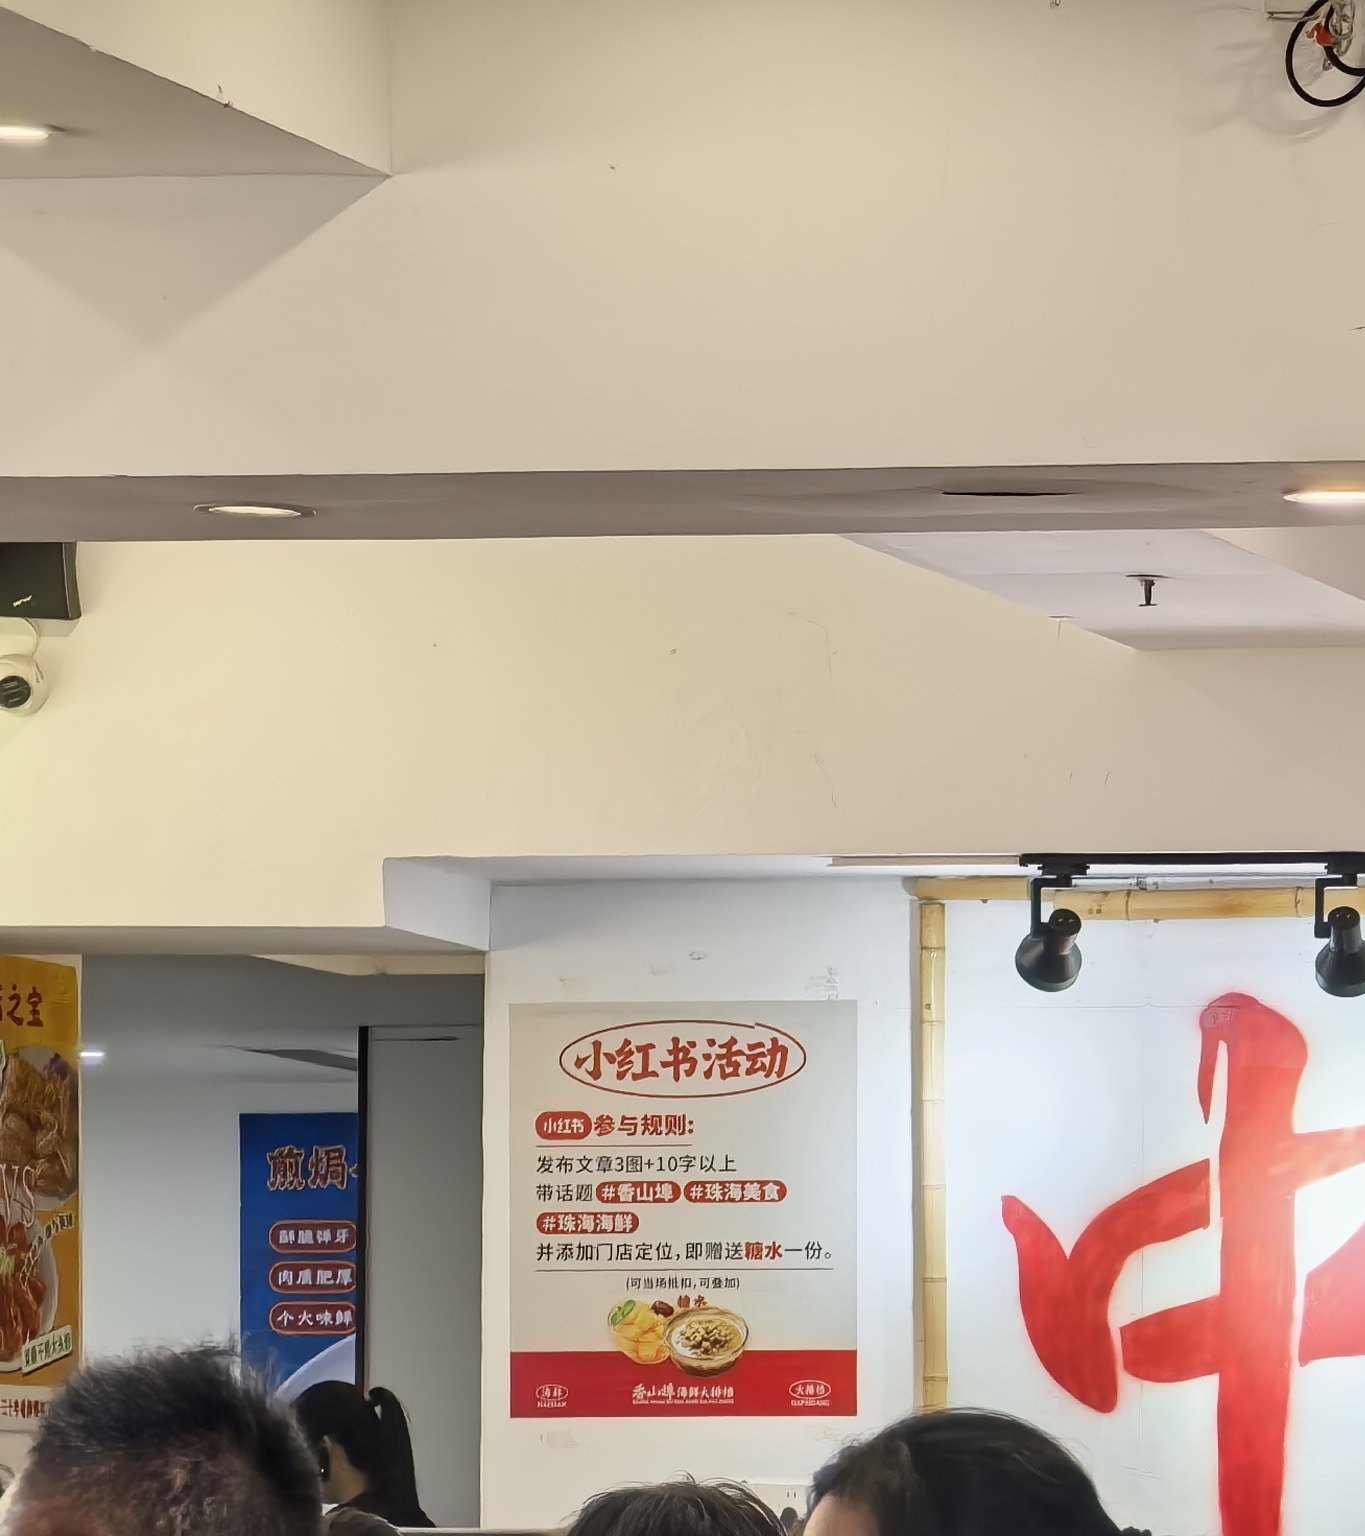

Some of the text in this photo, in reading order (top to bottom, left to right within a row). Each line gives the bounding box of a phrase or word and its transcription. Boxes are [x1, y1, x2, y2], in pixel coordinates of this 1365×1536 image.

[0, 984, 44, 1028] 之宝
[574, 1036, 789, 1082] 小红书活动
[543, 1117, 585, 1135] 小红书
[267, 1146, 357, 1191] 煎焗
[536, 1154, 737, 1174] 发布文章3图+10字以上
[536, 1183, 594, 1202] 带话题
[690, 1182, 781, 1202] #珠海美食
[542, 1213, 633, 1233] #珠海海鲜
